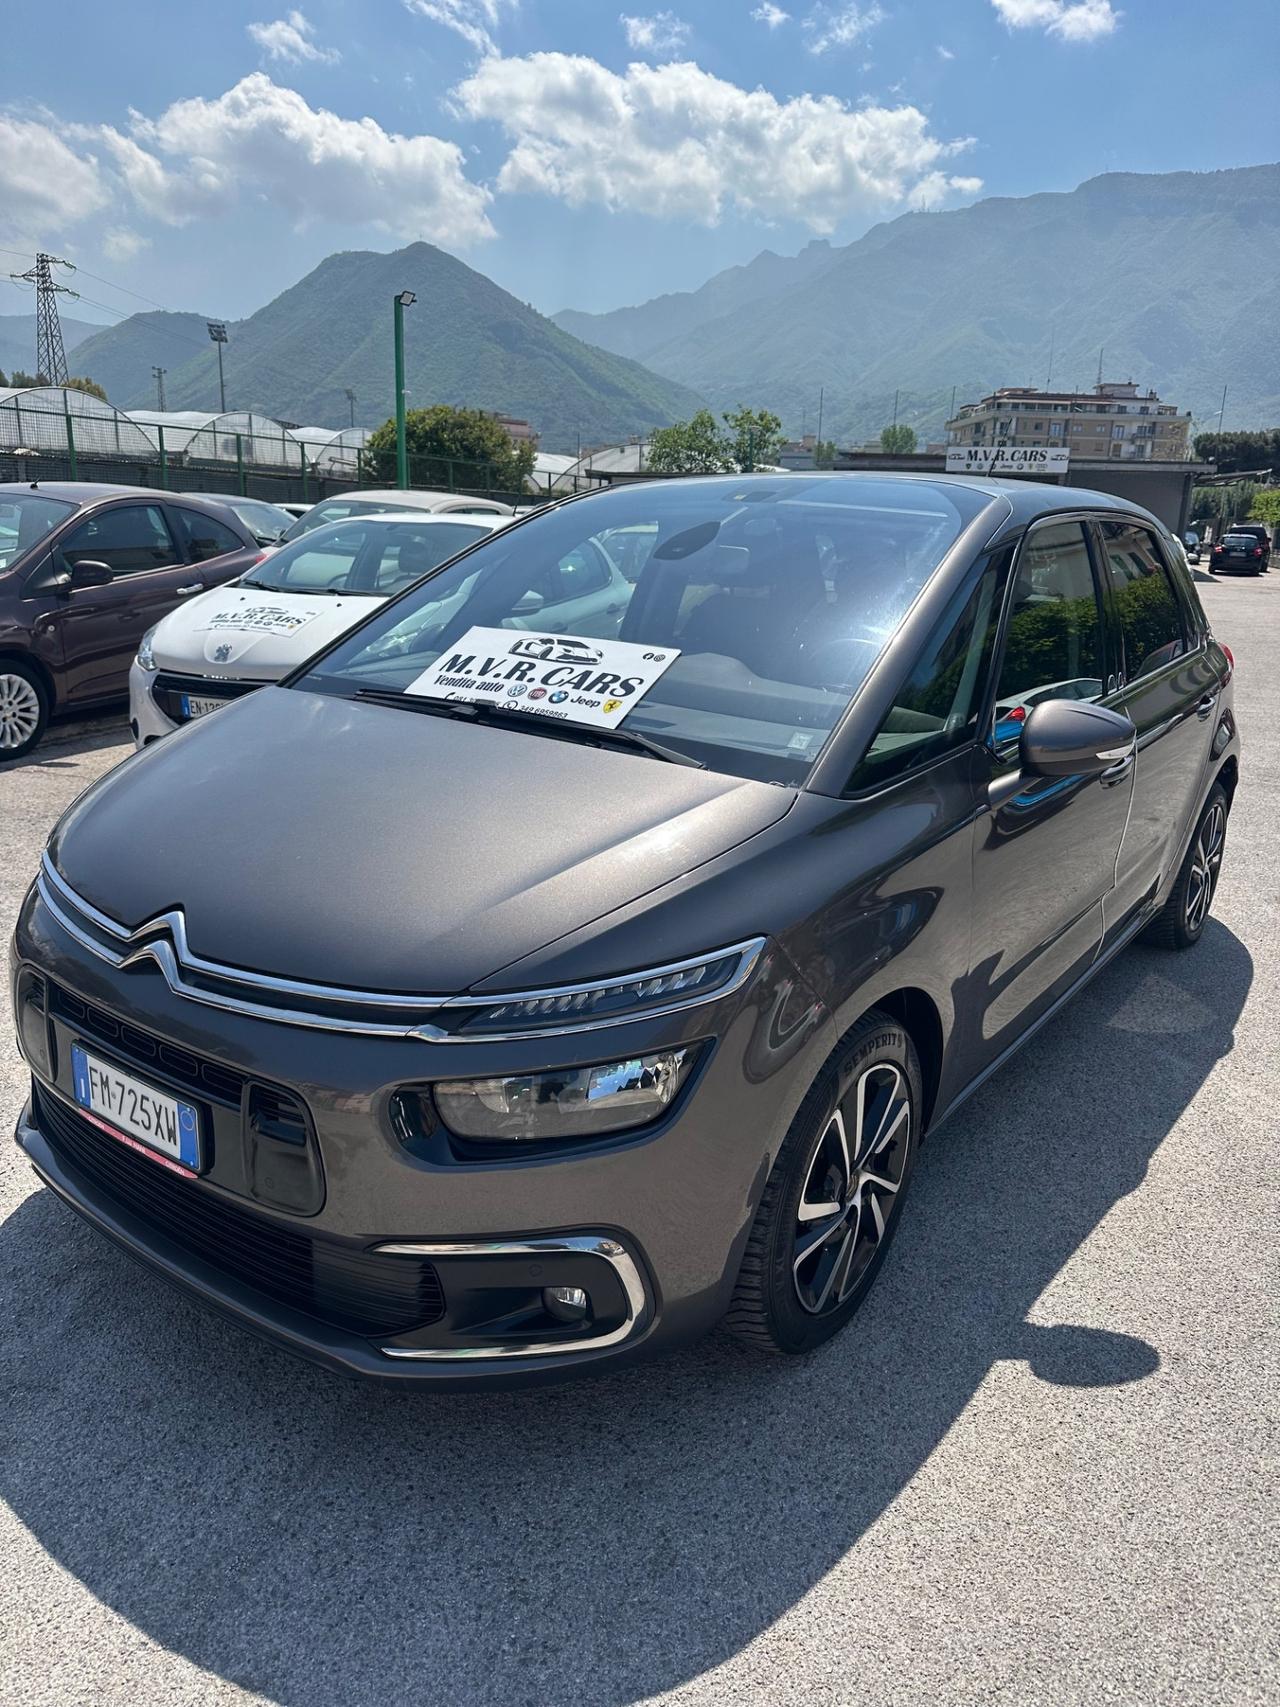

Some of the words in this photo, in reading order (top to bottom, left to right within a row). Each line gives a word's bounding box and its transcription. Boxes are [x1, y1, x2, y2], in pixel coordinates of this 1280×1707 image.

[433, 674, 478, 690] Vendita
[475, 680, 505, 693] auto
[570, 695, 601, 709] Jeep
